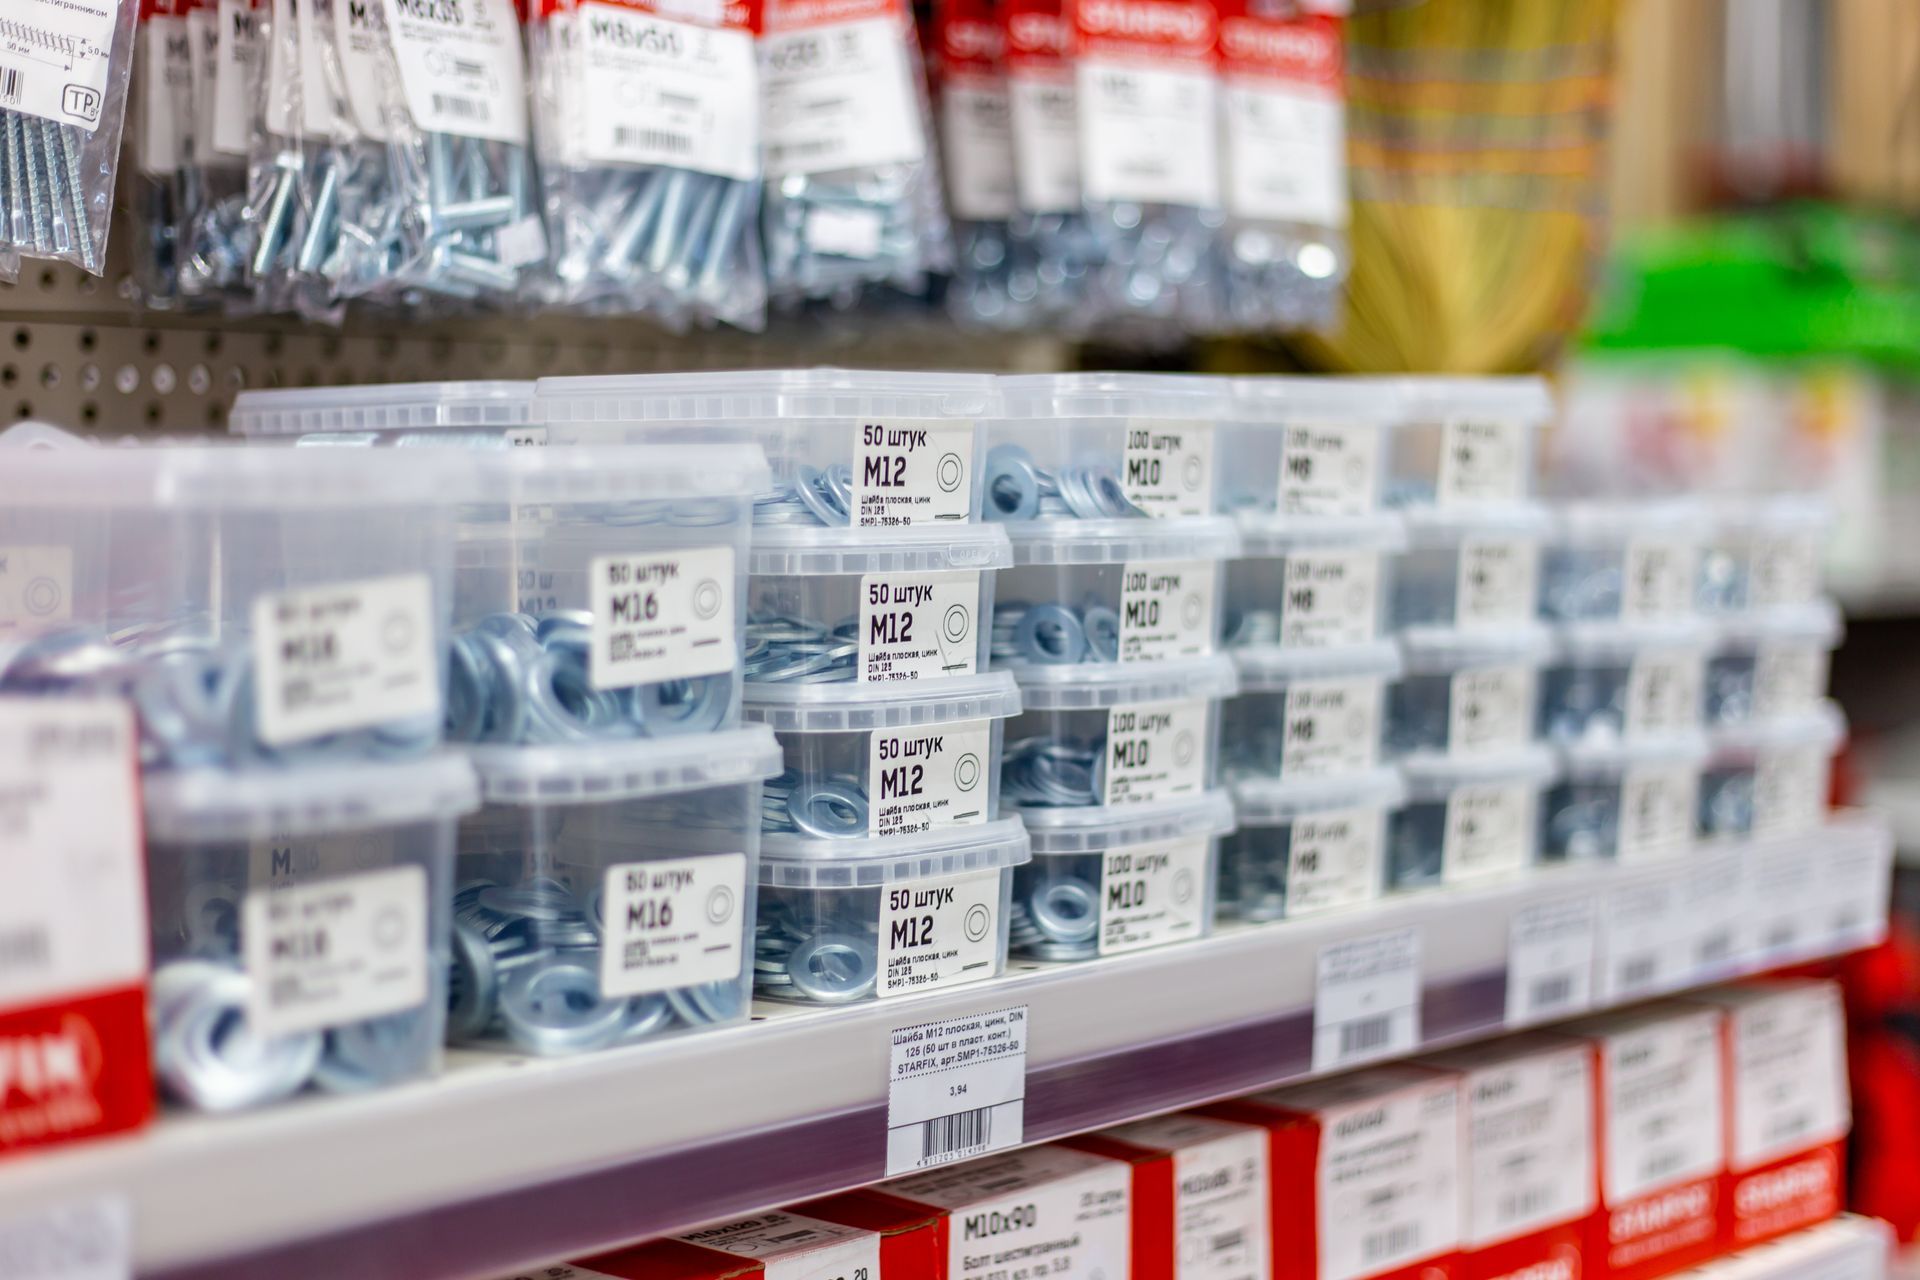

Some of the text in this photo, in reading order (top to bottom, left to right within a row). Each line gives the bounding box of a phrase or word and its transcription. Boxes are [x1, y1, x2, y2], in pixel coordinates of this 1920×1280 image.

[35, 0, 108, 18] стигранником
[6, 41, 17, 51] 50
[87, 46, 100, 57] 5,0
[864, 425, 927, 452] 50 штук
[1128, 430, 1182, 455] 100 штук
[864, 456, 906, 487] M12
[1127, 458, 1160, 486] M10
[861, 495, 884, 505] Шайба
[914, 496, 931, 504] цинк
[861, 506, 885, 515] DIN 125
[870, 584, 933, 607] 50 штук
[1125, 572, 1180, 596] 100 штук
[611, 591, 659, 625] M16
[1126, 600, 1159, 629] M10
[871, 612, 913, 645] M12
[868, 652, 891, 663] Шайба
[921, 649, 938, 659] цинк
[868, 662, 892, 673] DIN 125
[1113, 712, 1171, 734] 100 штук
[880, 736, 943, 760] 50 штук
[1113, 739, 1148, 769] M10
[881, 764, 924, 800] M12
[879, 805, 902, 817] Шайба
[933, 799, 949, 809] цинк
[879, 815, 903, 828] DIN 125
[1108, 852, 1169, 876] 100 штук
[890, 887, 954, 911] 50 штук
[1107, 880, 1146, 911] M10
[626, 897, 673, 933] M16
[890, 915, 934, 950] M12
[888, 955, 911, 968] Шайба
[942, 949, 959, 960] цинк
[888, 966, 912, 978] DIN 125
[893, 1030, 924, 1046] Шайба
[945, 1021, 982, 1036] плоская,
[985, 1016, 1006, 1028] цинк,
[1009, 1011, 1024, 1023] DIN
[905, 1028, 1011, 1058] 125 (50 шт в пласт. конт.)
[898, 1057, 939, 1075] STARFIX,
[949, 1083, 968, 1097] 3,94
[964, 1204, 1037, 1242] M10x90
[963, 1254, 991, 1271] Болт
